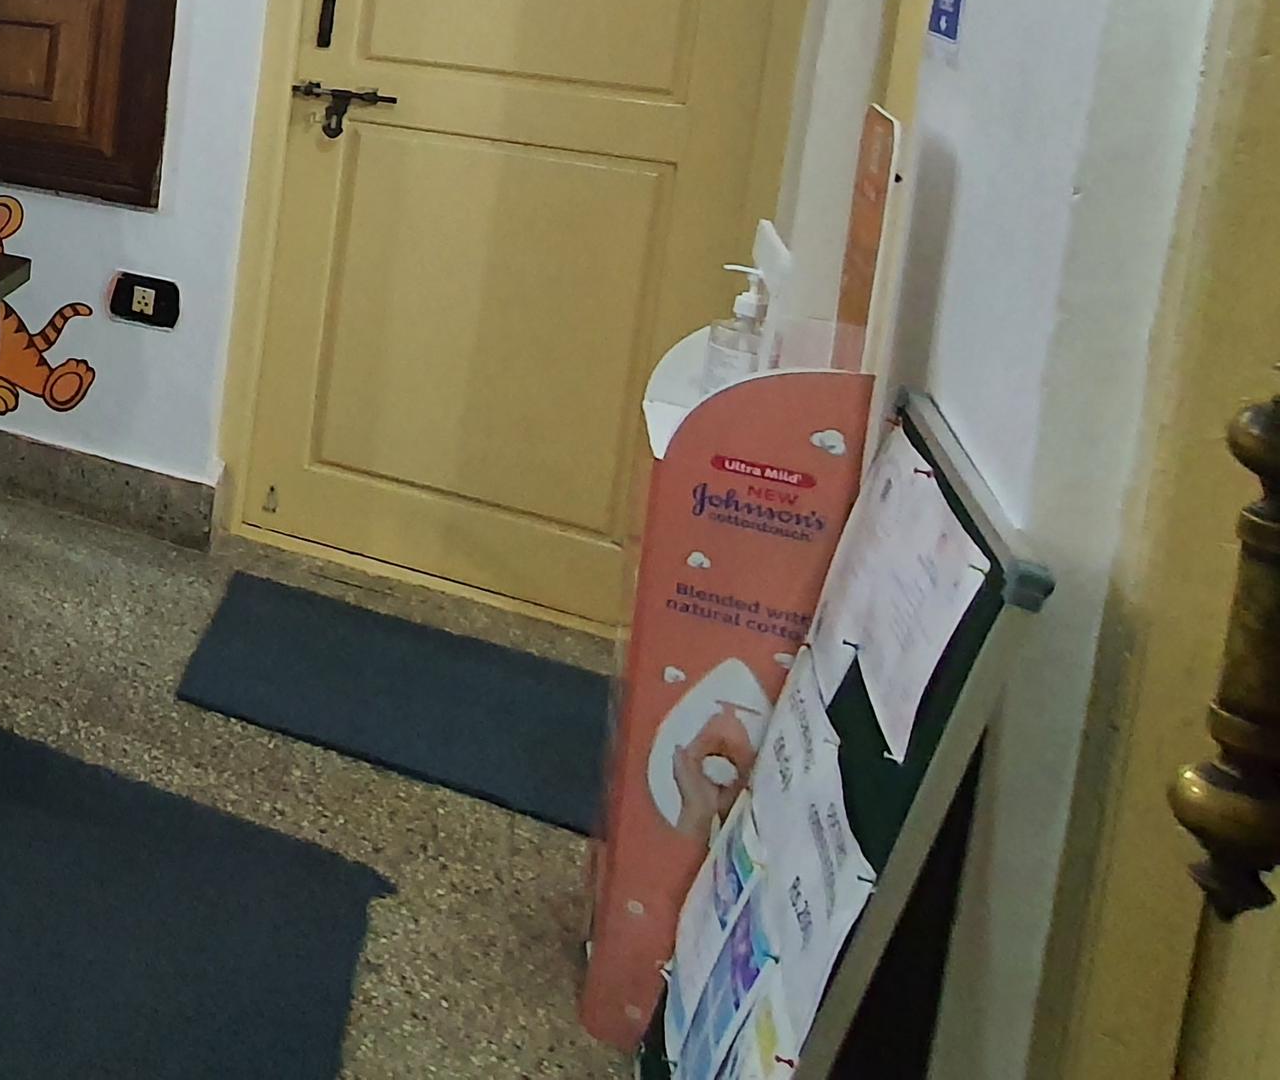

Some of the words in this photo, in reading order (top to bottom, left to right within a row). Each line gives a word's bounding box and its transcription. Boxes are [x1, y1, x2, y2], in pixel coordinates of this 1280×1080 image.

[724, 459, 762, 477] Ultra
[692, 482, 825, 531] Johnson's
[747, 485, 800, 506] NEW
[676, 582, 760, 614] Blended
[665, 598, 741, 626] natural
[746, 619, 806, 642] cotto
